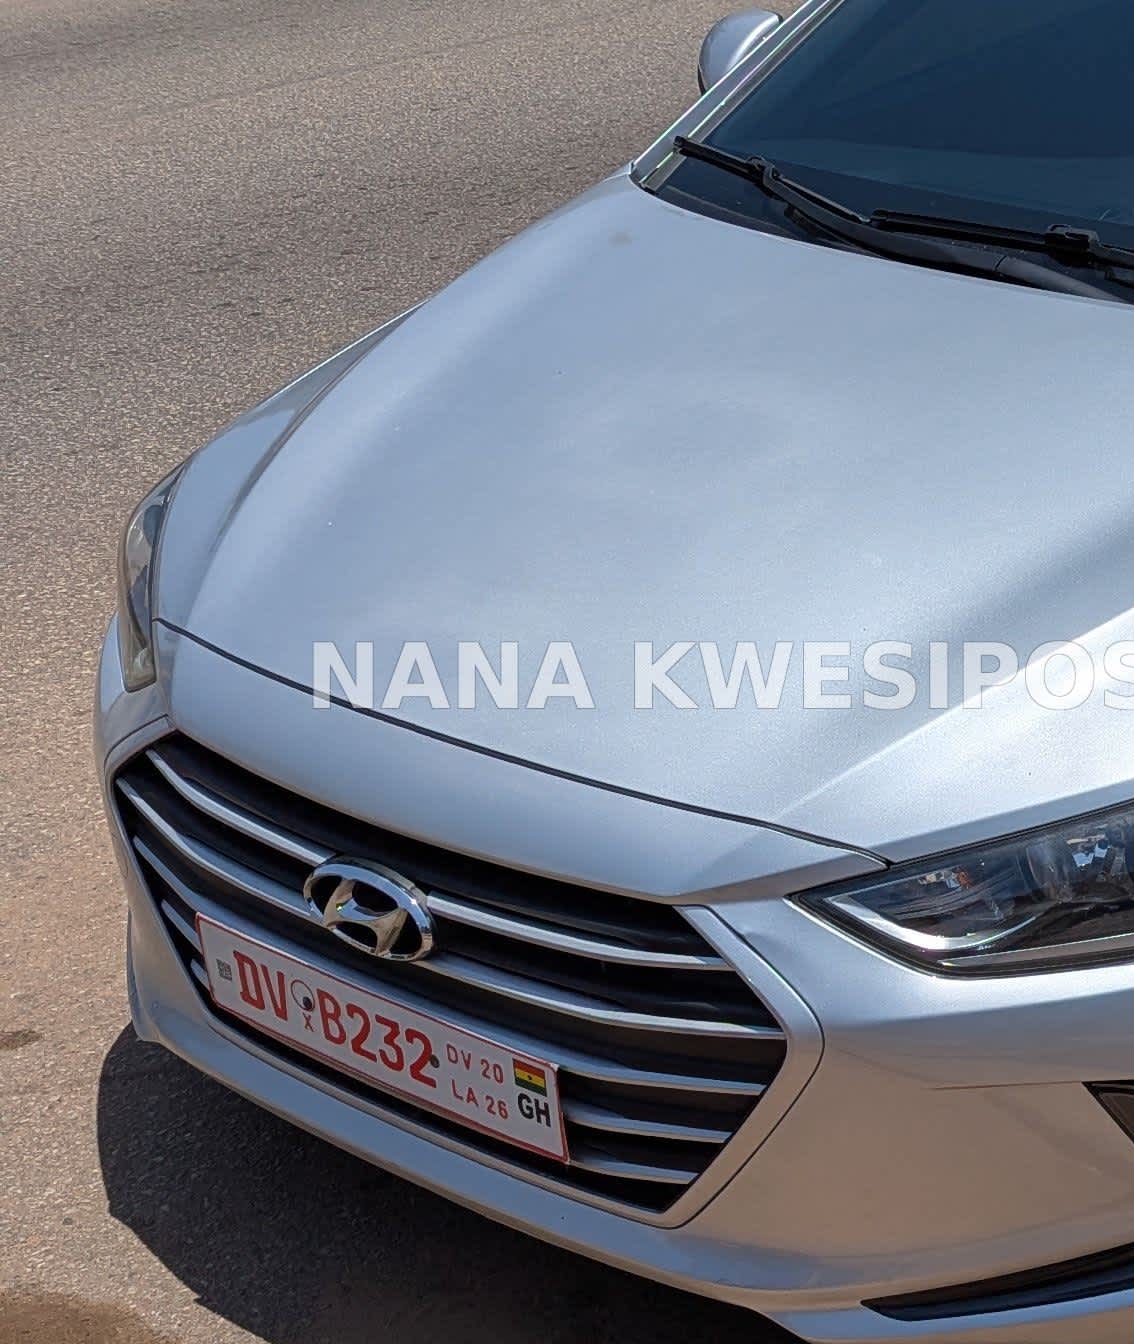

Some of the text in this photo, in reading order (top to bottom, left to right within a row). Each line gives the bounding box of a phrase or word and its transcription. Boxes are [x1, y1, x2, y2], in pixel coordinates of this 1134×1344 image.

[233, 950, 437, 1089] DV B232
[446, 1043, 504, 1084] DV 20
[452, 1079, 509, 1120] LA 26
[517, 1092, 552, 1128] GH
